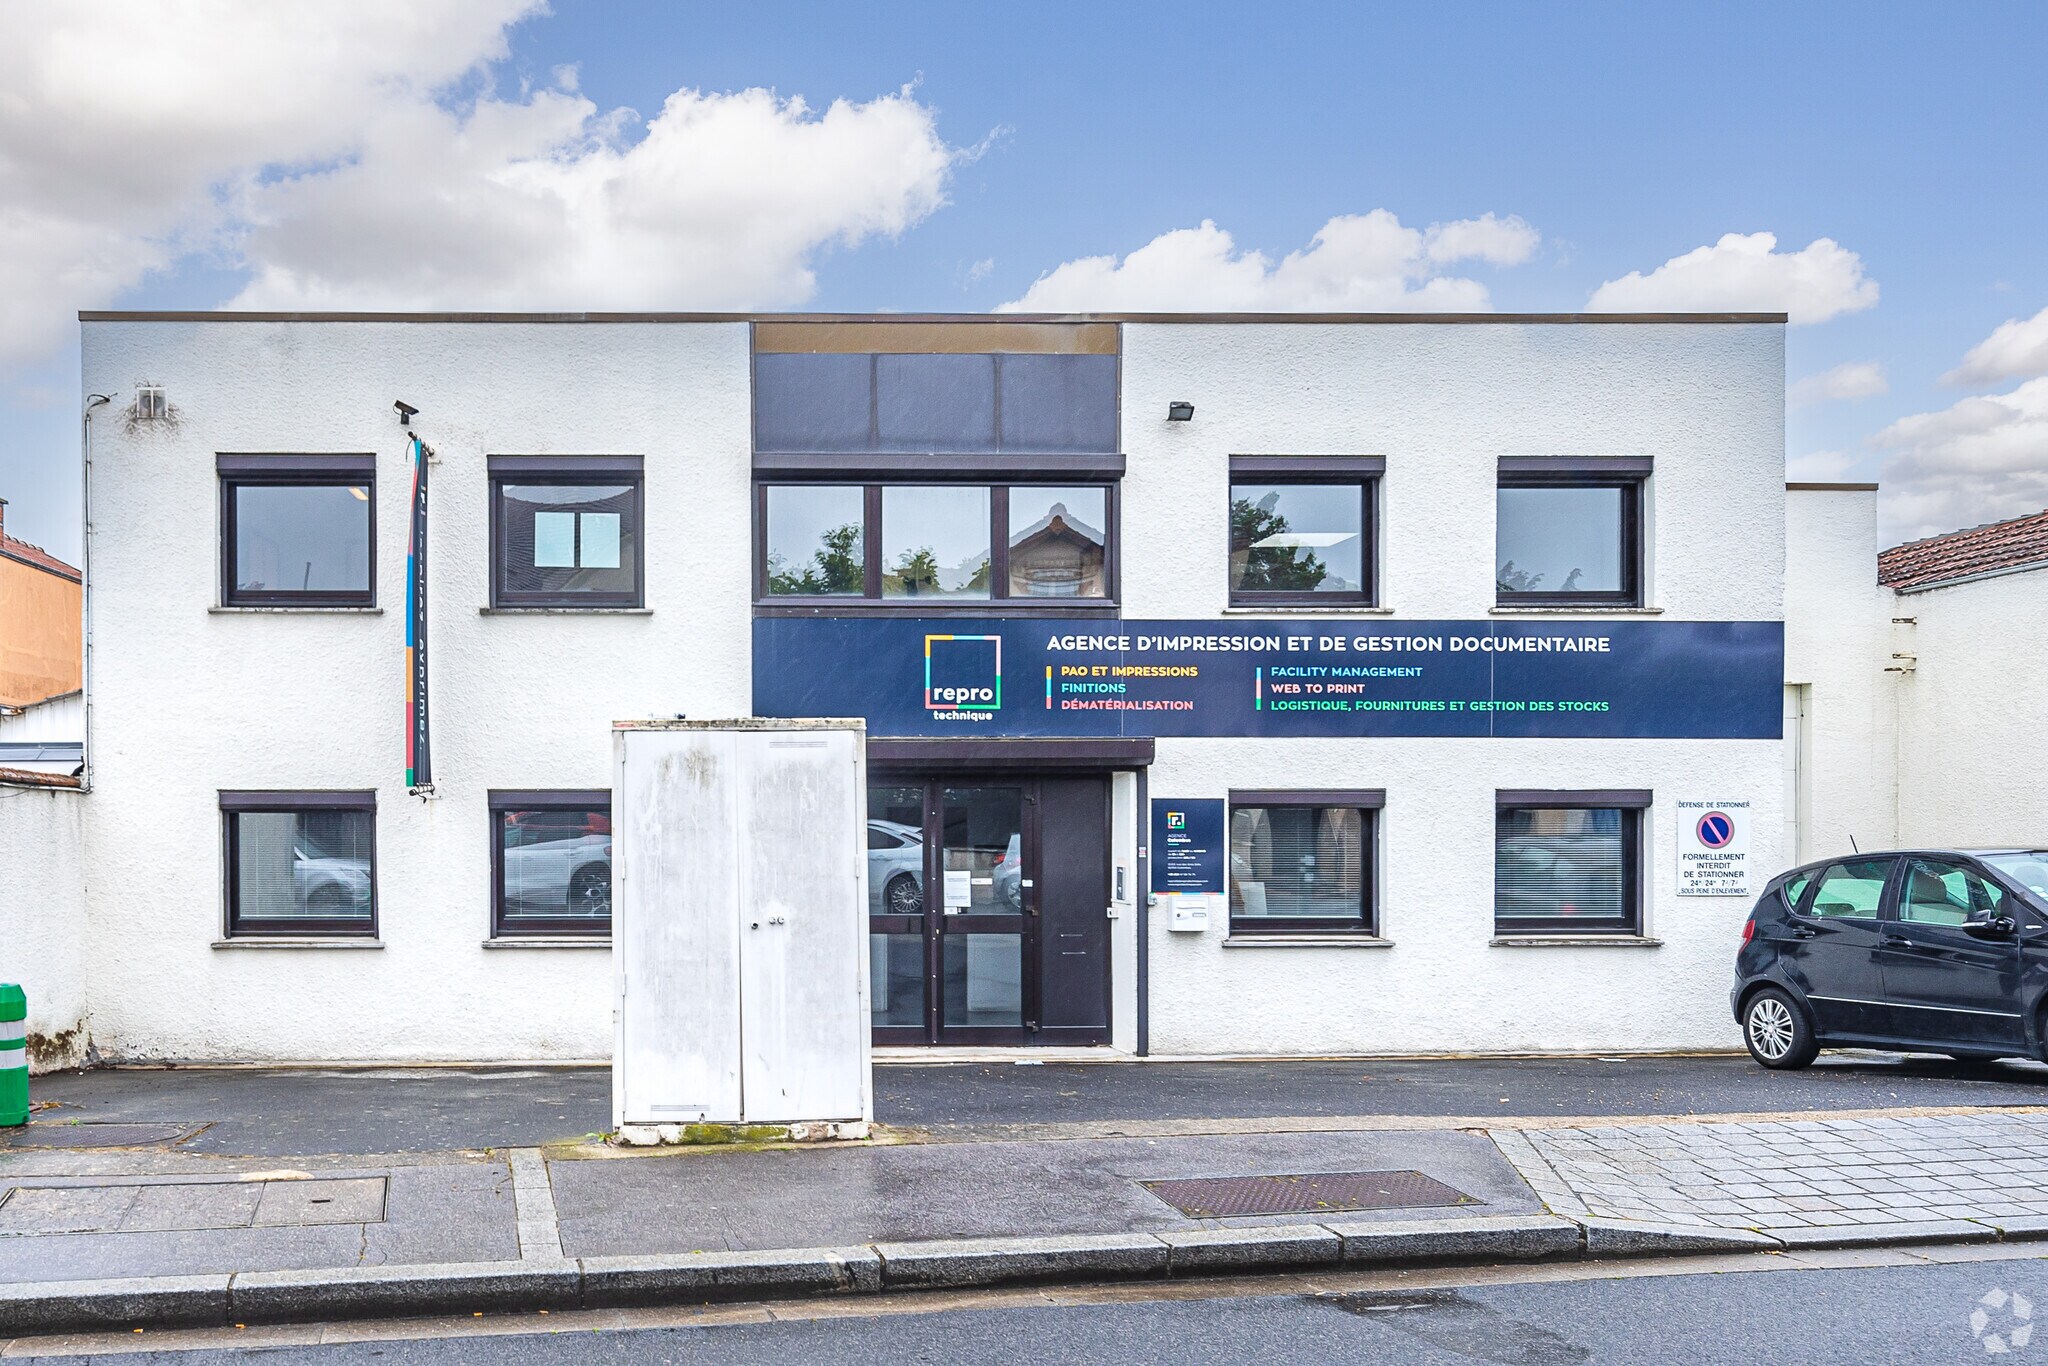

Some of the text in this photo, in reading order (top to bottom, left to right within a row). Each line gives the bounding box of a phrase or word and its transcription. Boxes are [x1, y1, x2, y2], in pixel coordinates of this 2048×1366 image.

[1046, 636, 1131, 652] AGENCE
[1287, 636, 1314, 652] ET
[1319, 636, 1347, 652] DE
[1352, 636, 1443, 652] GESTION
[1449, 636, 1611, 652] DOCUMENTAIRE
[1061, 666, 1198, 677] PAO ET IMPRESSIONS
[1271, 666, 1424, 677] FACILITY MANAGEMENT
[1061, 683, 1127, 693] FINITIONS
[1270, 683, 1366, 694] WEB TO PRINT
[933, 686, 994, 704] repro
[1061, 698, 1194, 711] DÉMATÉRIALISATION
[1271, 700, 1609, 712] LOGISTIQUE, FOURNITURES ET GESTION DES STOCKS
[933, 710, 993, 722] technique
[1682, 853, 1746, 861] FORMELLEMENT
[1696, 862, 1731, 870] INTERDIT
[1683, 870, 1745, 878] DE STATIONNER
